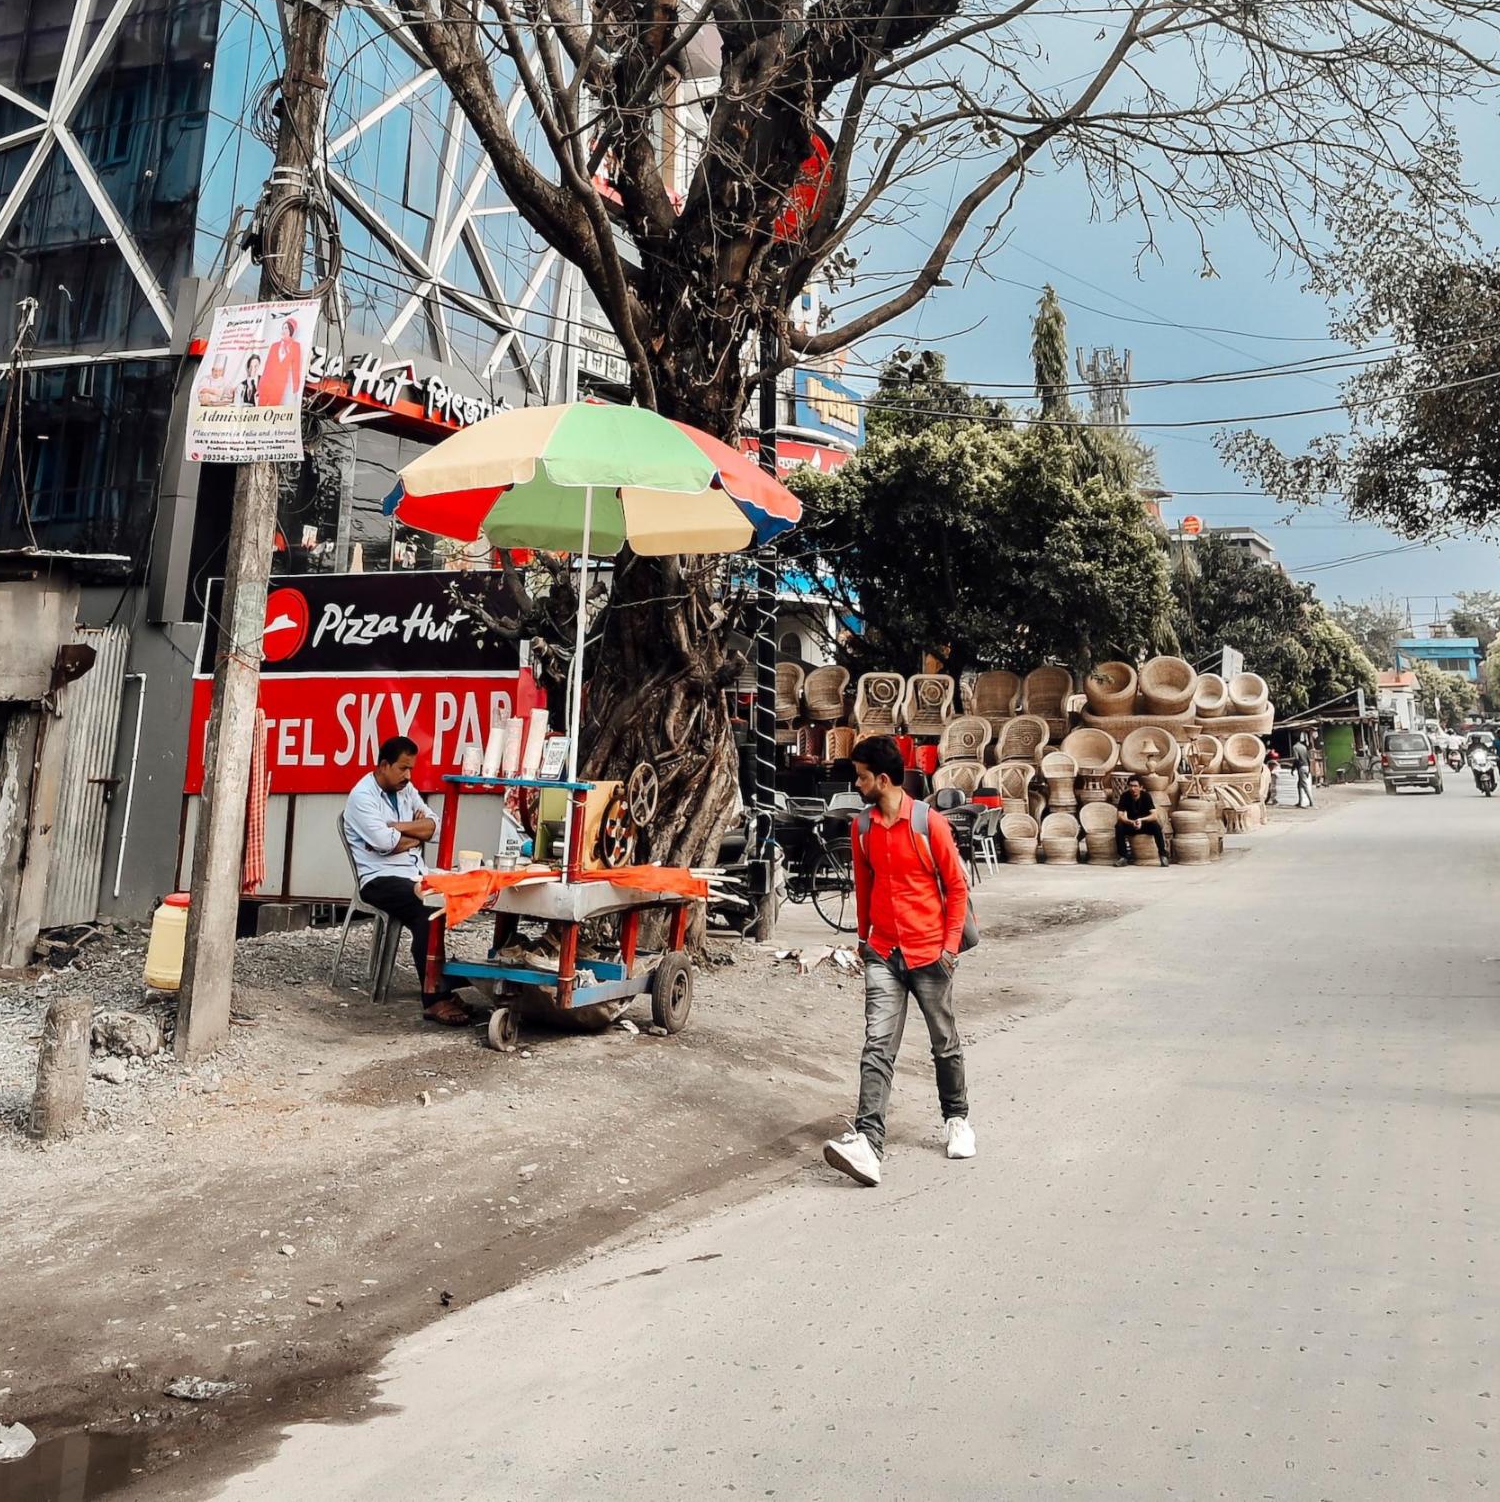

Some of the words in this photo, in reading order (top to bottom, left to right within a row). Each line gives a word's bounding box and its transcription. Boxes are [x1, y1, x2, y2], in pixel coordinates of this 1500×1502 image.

[352, 353, 414, 406] Hut
[196, 410, 260, 423] Admission
[263, 409, 294, 424] Open
[312, 602, 398, 647] Pizza
[402, 602, 470, 644] Hut
[333, 692, 422, 766] SKY
